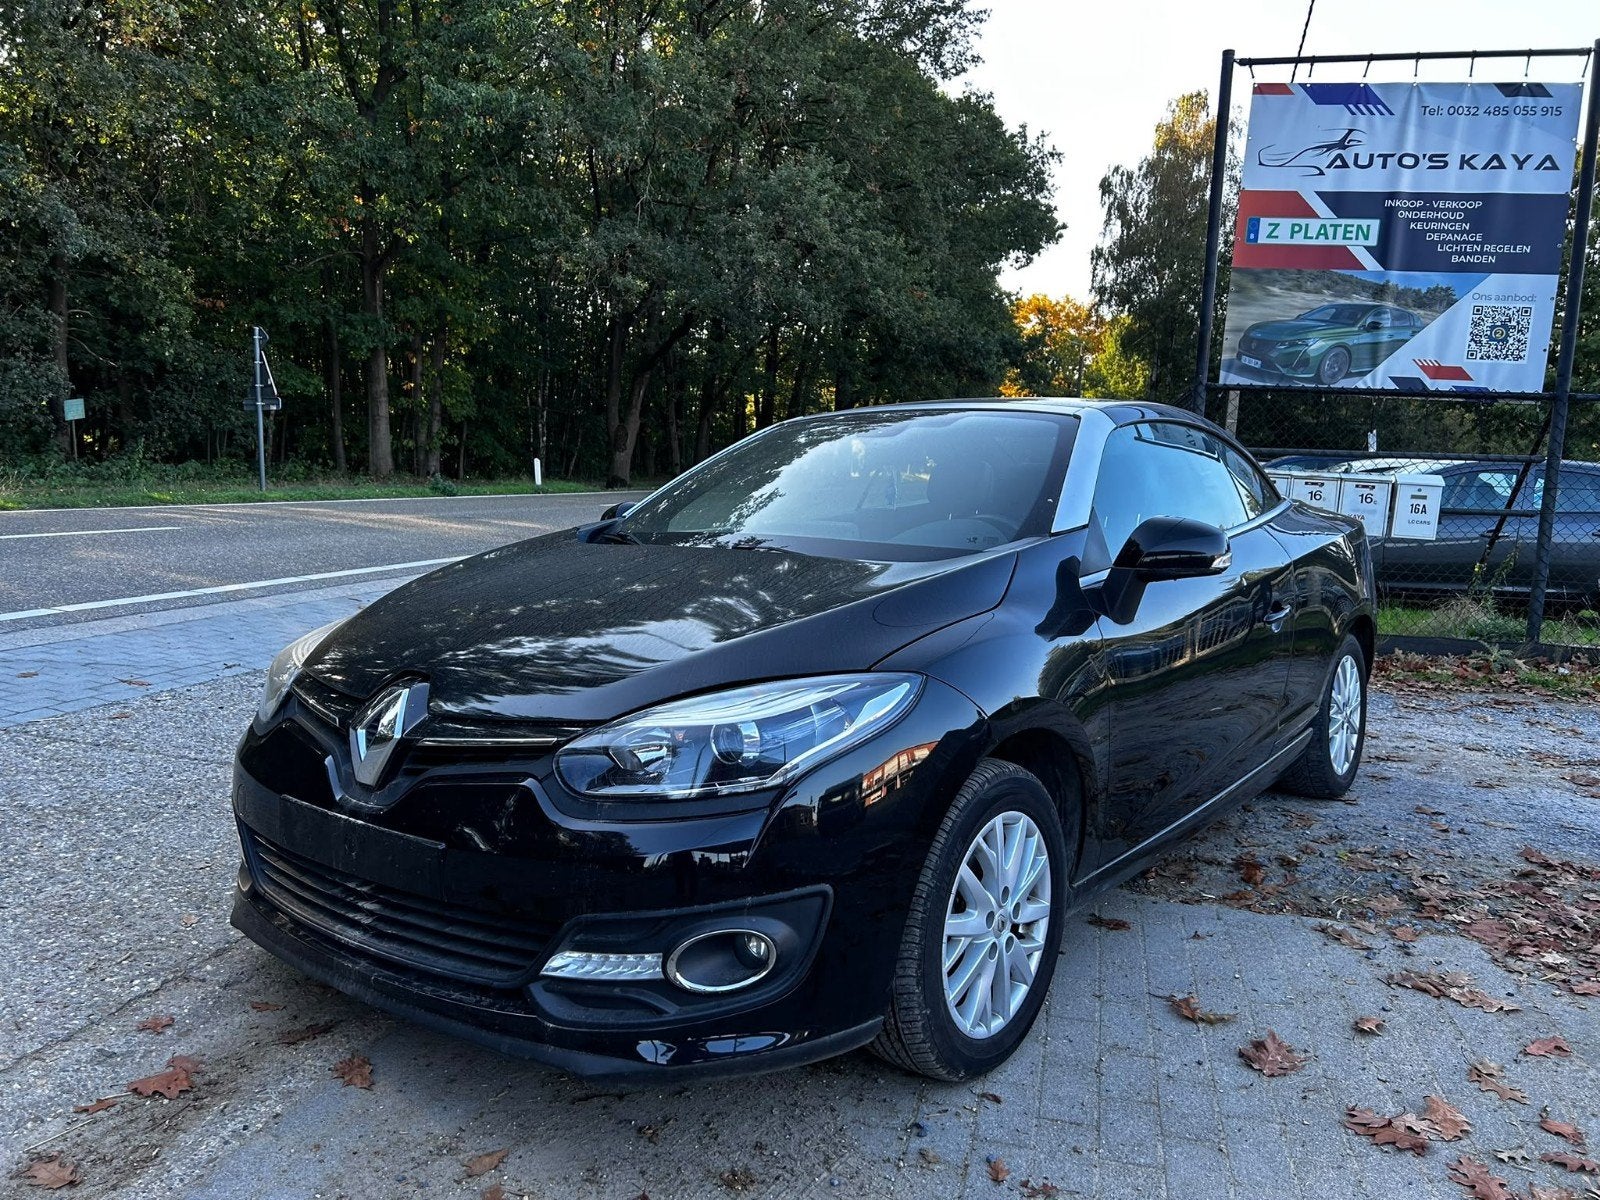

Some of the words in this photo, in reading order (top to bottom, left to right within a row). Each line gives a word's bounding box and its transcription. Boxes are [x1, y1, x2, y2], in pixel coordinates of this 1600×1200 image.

[1421, 105, 1443, 116] Tel:
[1447, 105, 1479, 117] 0032
[1483, 105, 1509, 117] 485
[1513, 105, 1537, 117] 055
[1540, 106, 1562, 117] 915
[1325, 152, 1449, 170] AUTO'S
[1458, 153, 1560, 171] KAYA
[1384, 199, 1424, 209] INKOOP
[1432, 200, 1483, 209] VERKOOP
[1397, 210, 1465, 220] ONDERHOUD
[1409, 221, 1470, 231] KEURINGEN
[1265, 222, 1281, 239] Z
[1289, 222, 1371, 241] PLATEN
[1425, 232, 1483, 242] DEPANAGE
[1437, 243, 1481, 253] LICHTEN
[1483, 244, 1531, 254] REGELEN
[1451, 254, 1496, 264] BANDEN
[1472, 292, 1492, 301] Ons
[1494, 293, 1537, 302] aanbod:
[1410, 503, 1427, 515] 16A
